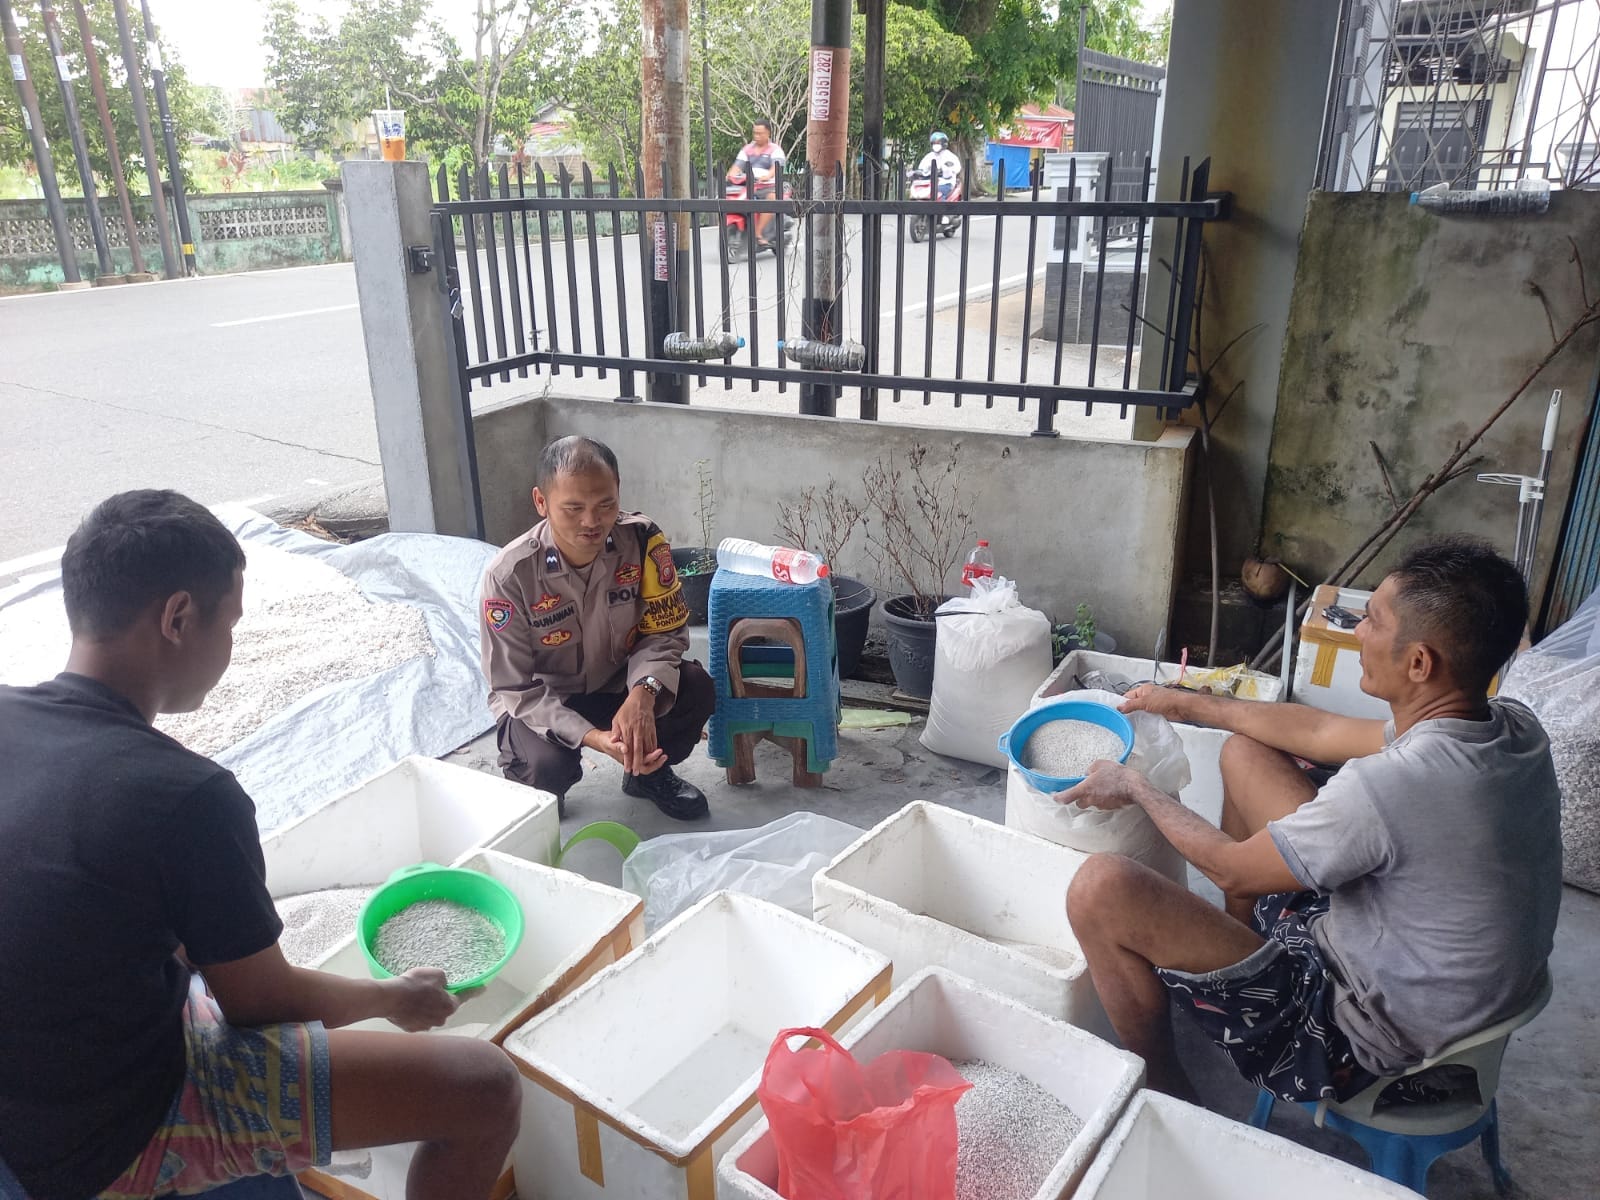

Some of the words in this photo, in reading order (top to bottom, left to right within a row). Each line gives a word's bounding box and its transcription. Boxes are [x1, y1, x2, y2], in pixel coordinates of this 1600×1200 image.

[816, 52, 832, 73] 2827
[815, 76, 831, 96] 5151
[814, 98, 830, 119] 0813
